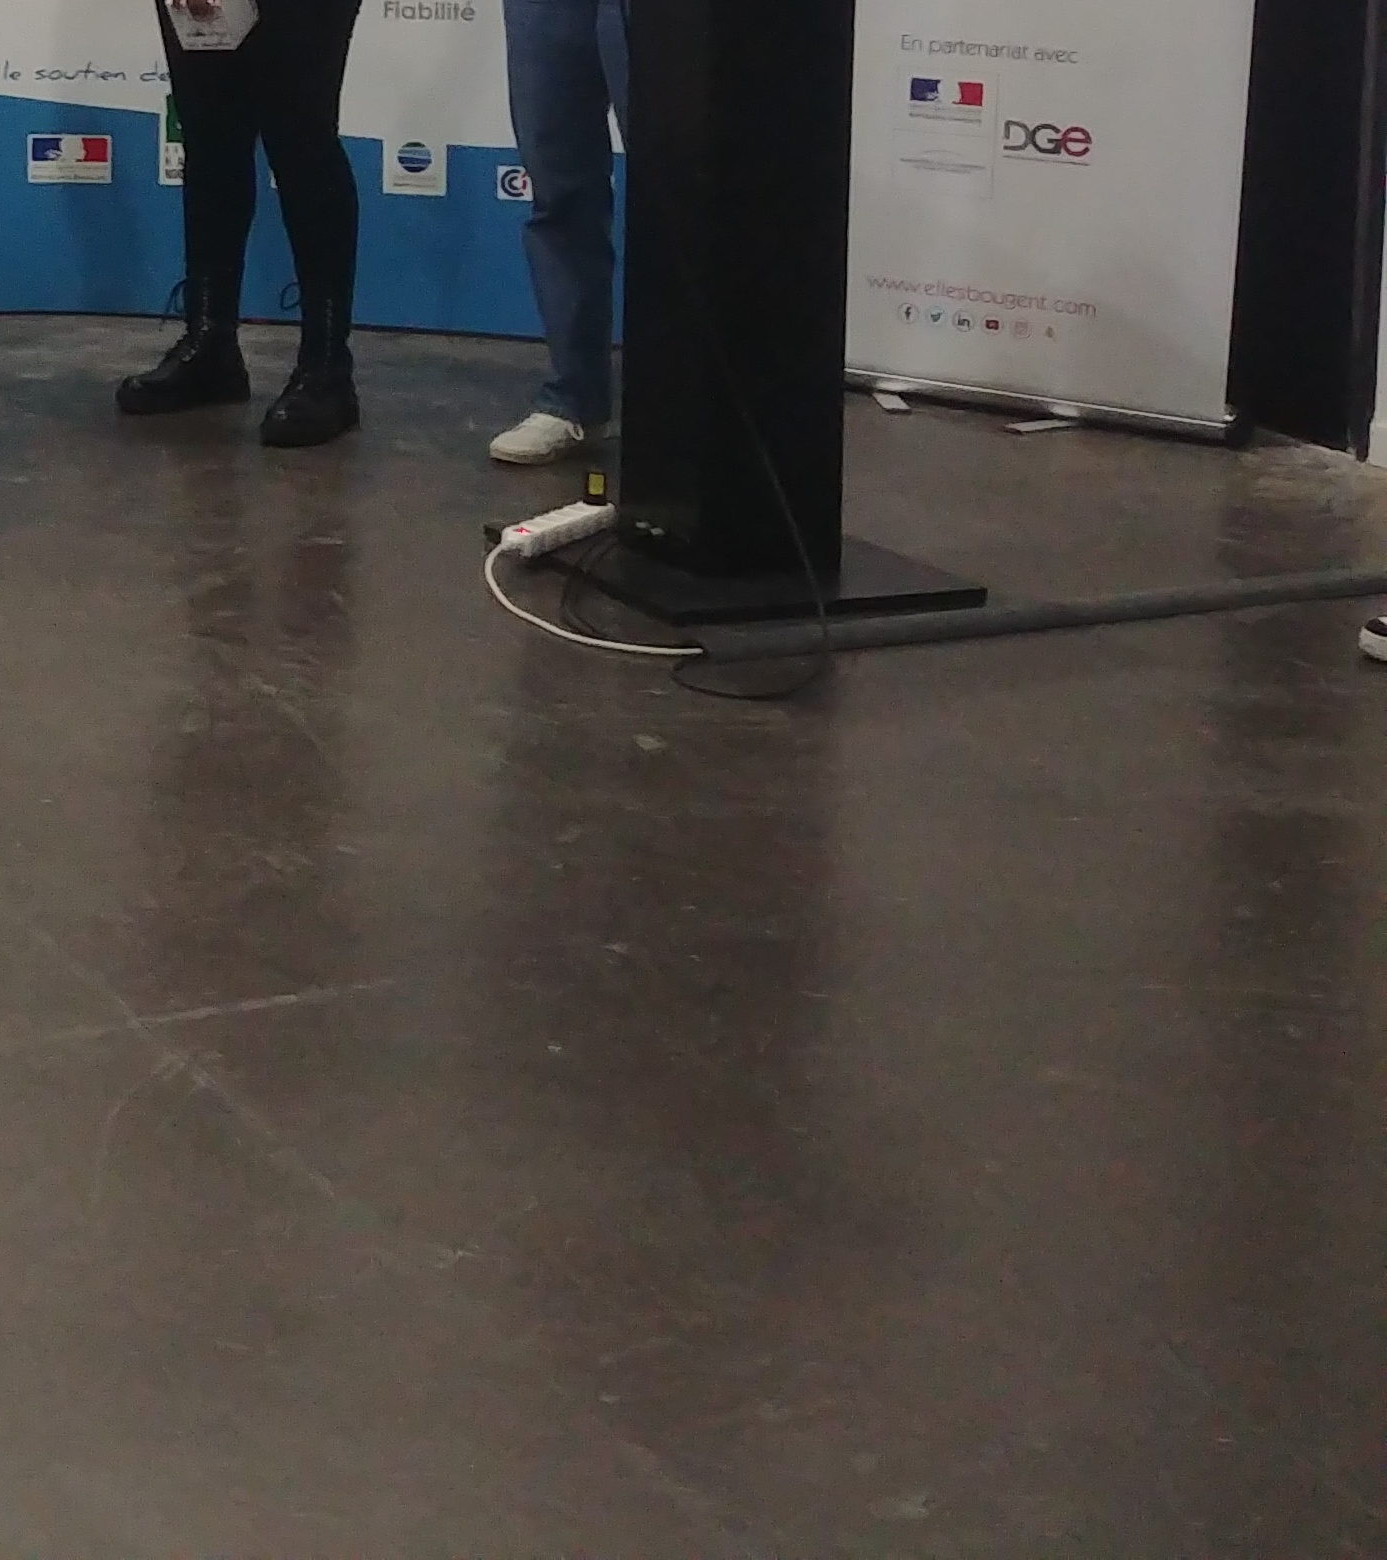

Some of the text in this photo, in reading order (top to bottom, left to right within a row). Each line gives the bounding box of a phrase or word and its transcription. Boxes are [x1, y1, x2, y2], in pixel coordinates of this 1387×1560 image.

[383, 0, 476, 21] Fiabilité
[900, 34, 1080, 65] En partenariat avec
[3, 60, 22, 82] le
[35, 61, 127, 82] soutien
